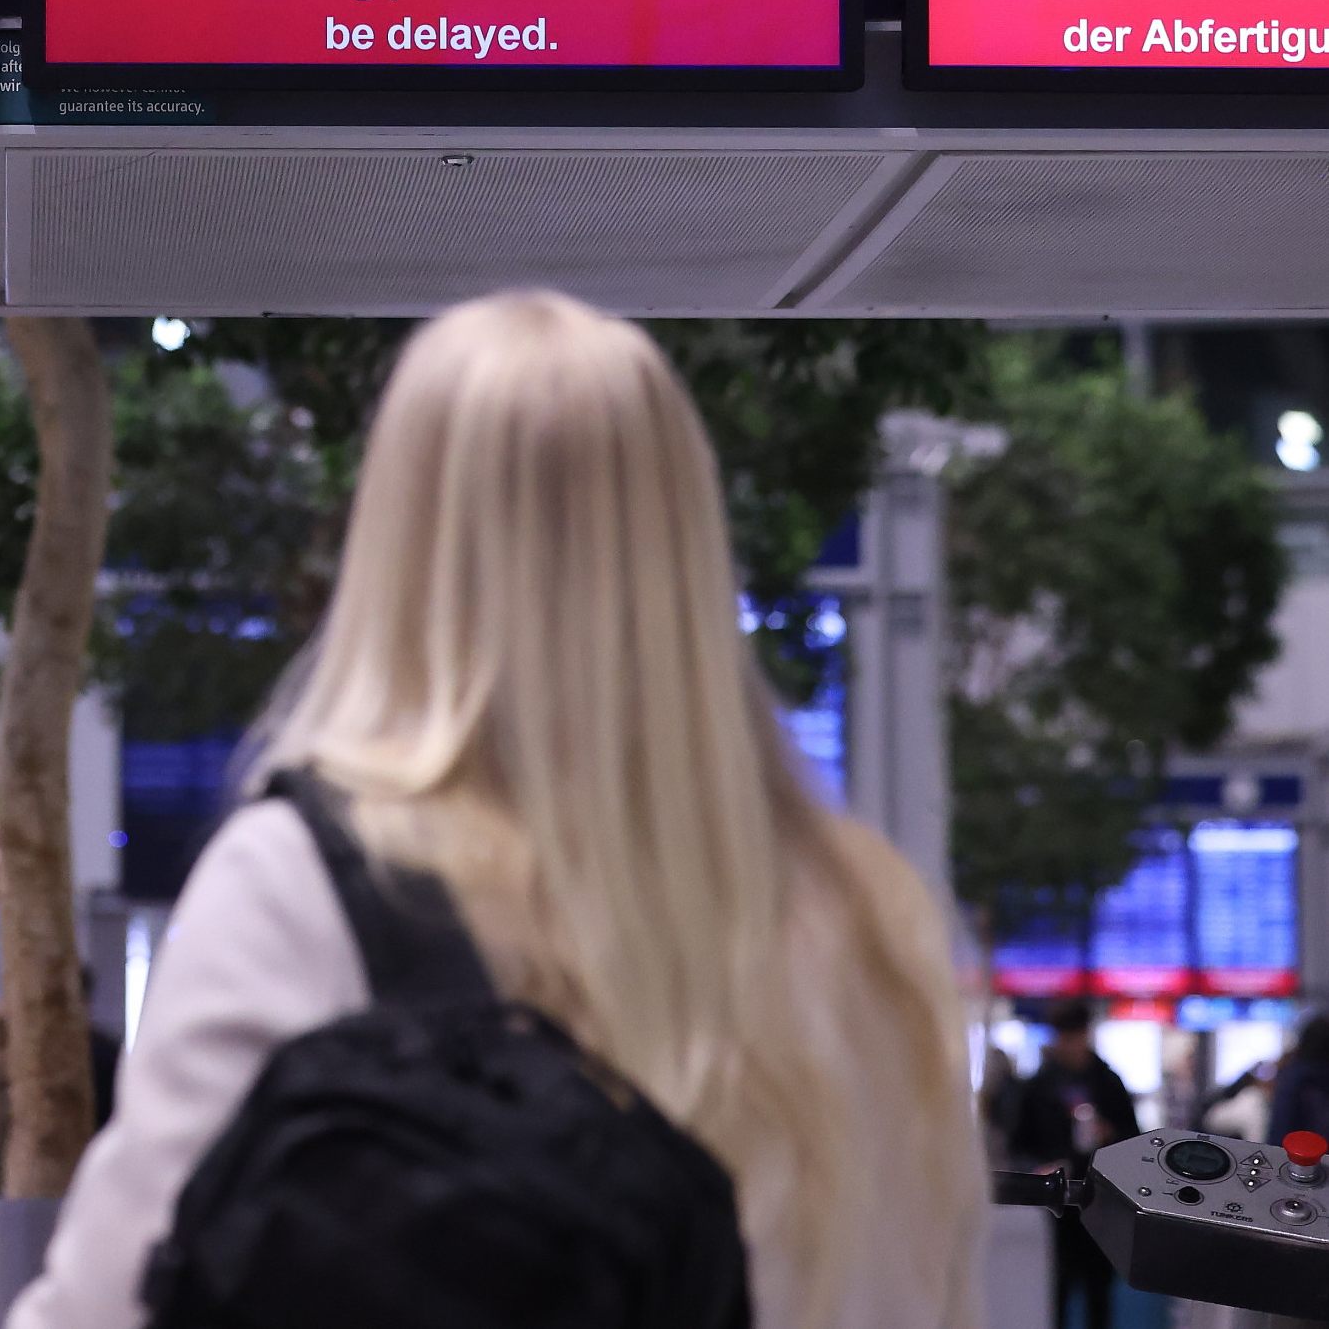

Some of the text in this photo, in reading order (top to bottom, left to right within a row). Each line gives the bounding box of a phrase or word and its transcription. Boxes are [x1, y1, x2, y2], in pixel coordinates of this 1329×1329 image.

[327, 17, 557, 59] be delayed.
[1064, 19, 1131, 52] der
[0, 79, 21, 92] wir
[59, 99, 205, 116] guarantee its accuracy.
